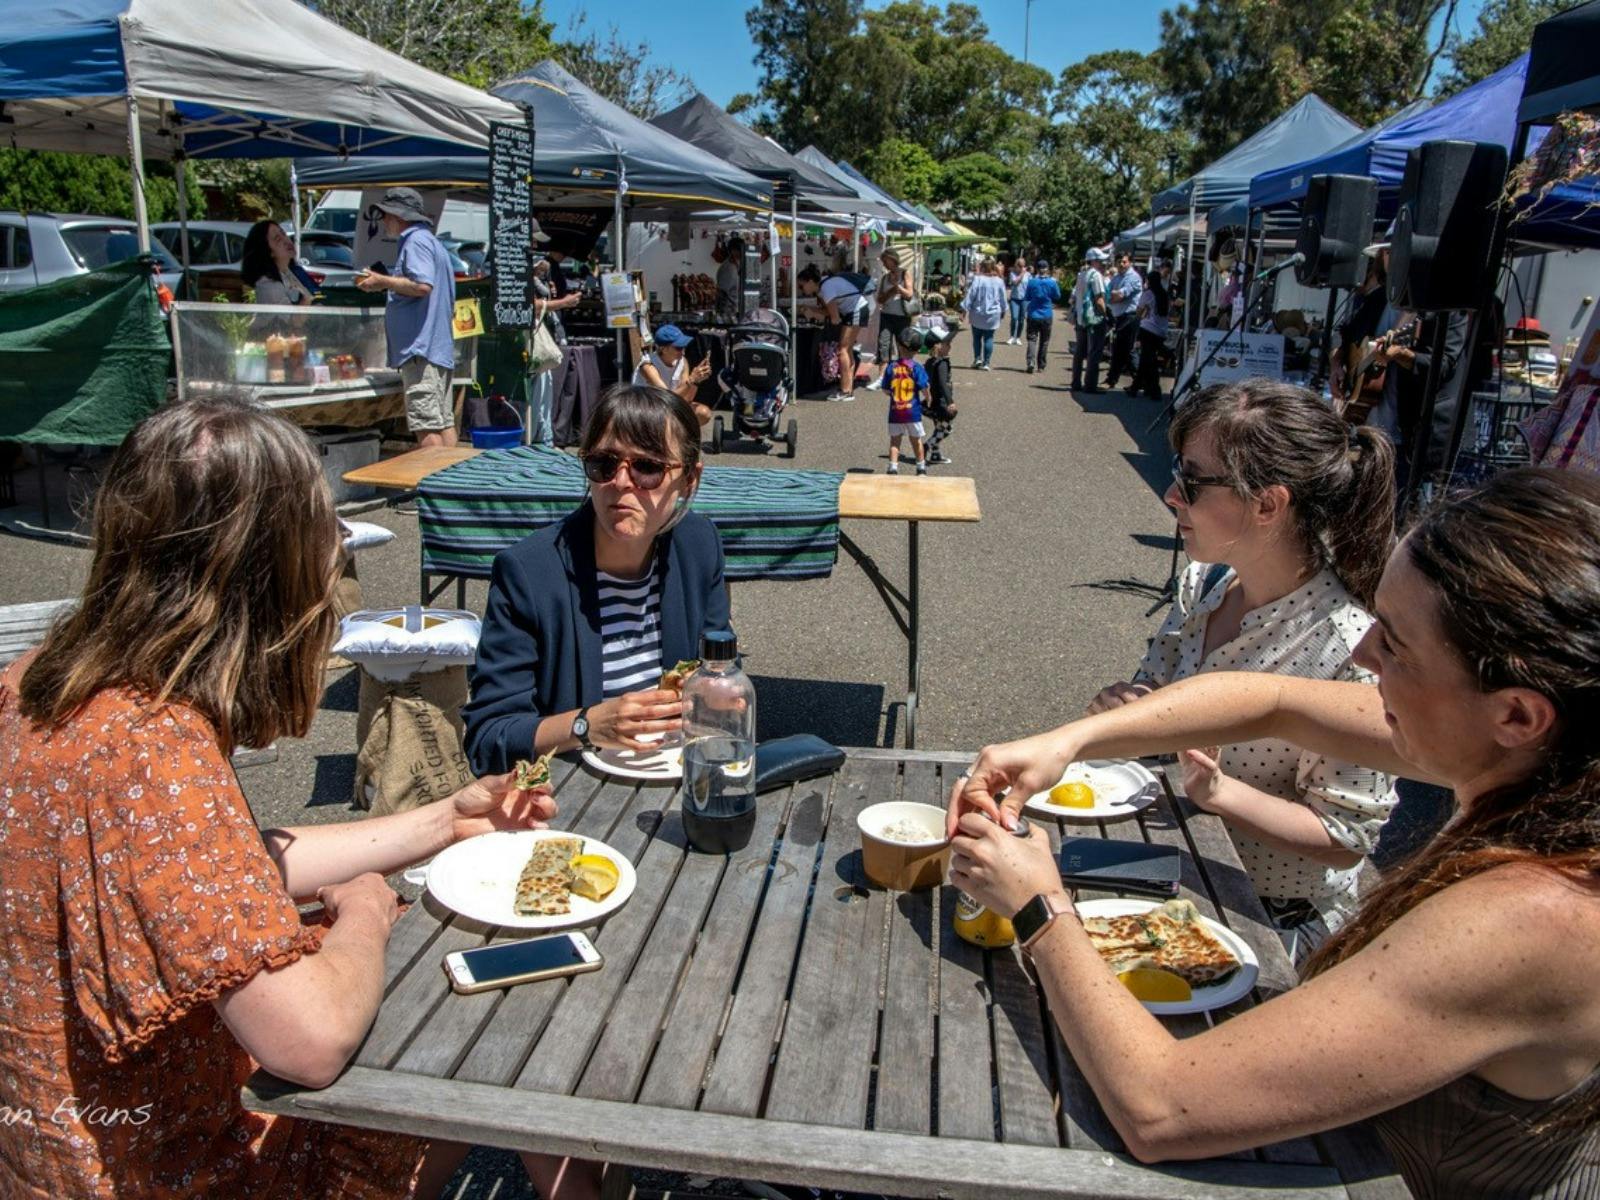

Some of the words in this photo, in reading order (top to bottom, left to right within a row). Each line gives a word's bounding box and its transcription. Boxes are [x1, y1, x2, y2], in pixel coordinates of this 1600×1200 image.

[1207, 341, 1249, 349] KOBUCHA
[452, 753, 469, 786] COS
[433, 771, 453, 798] FO
